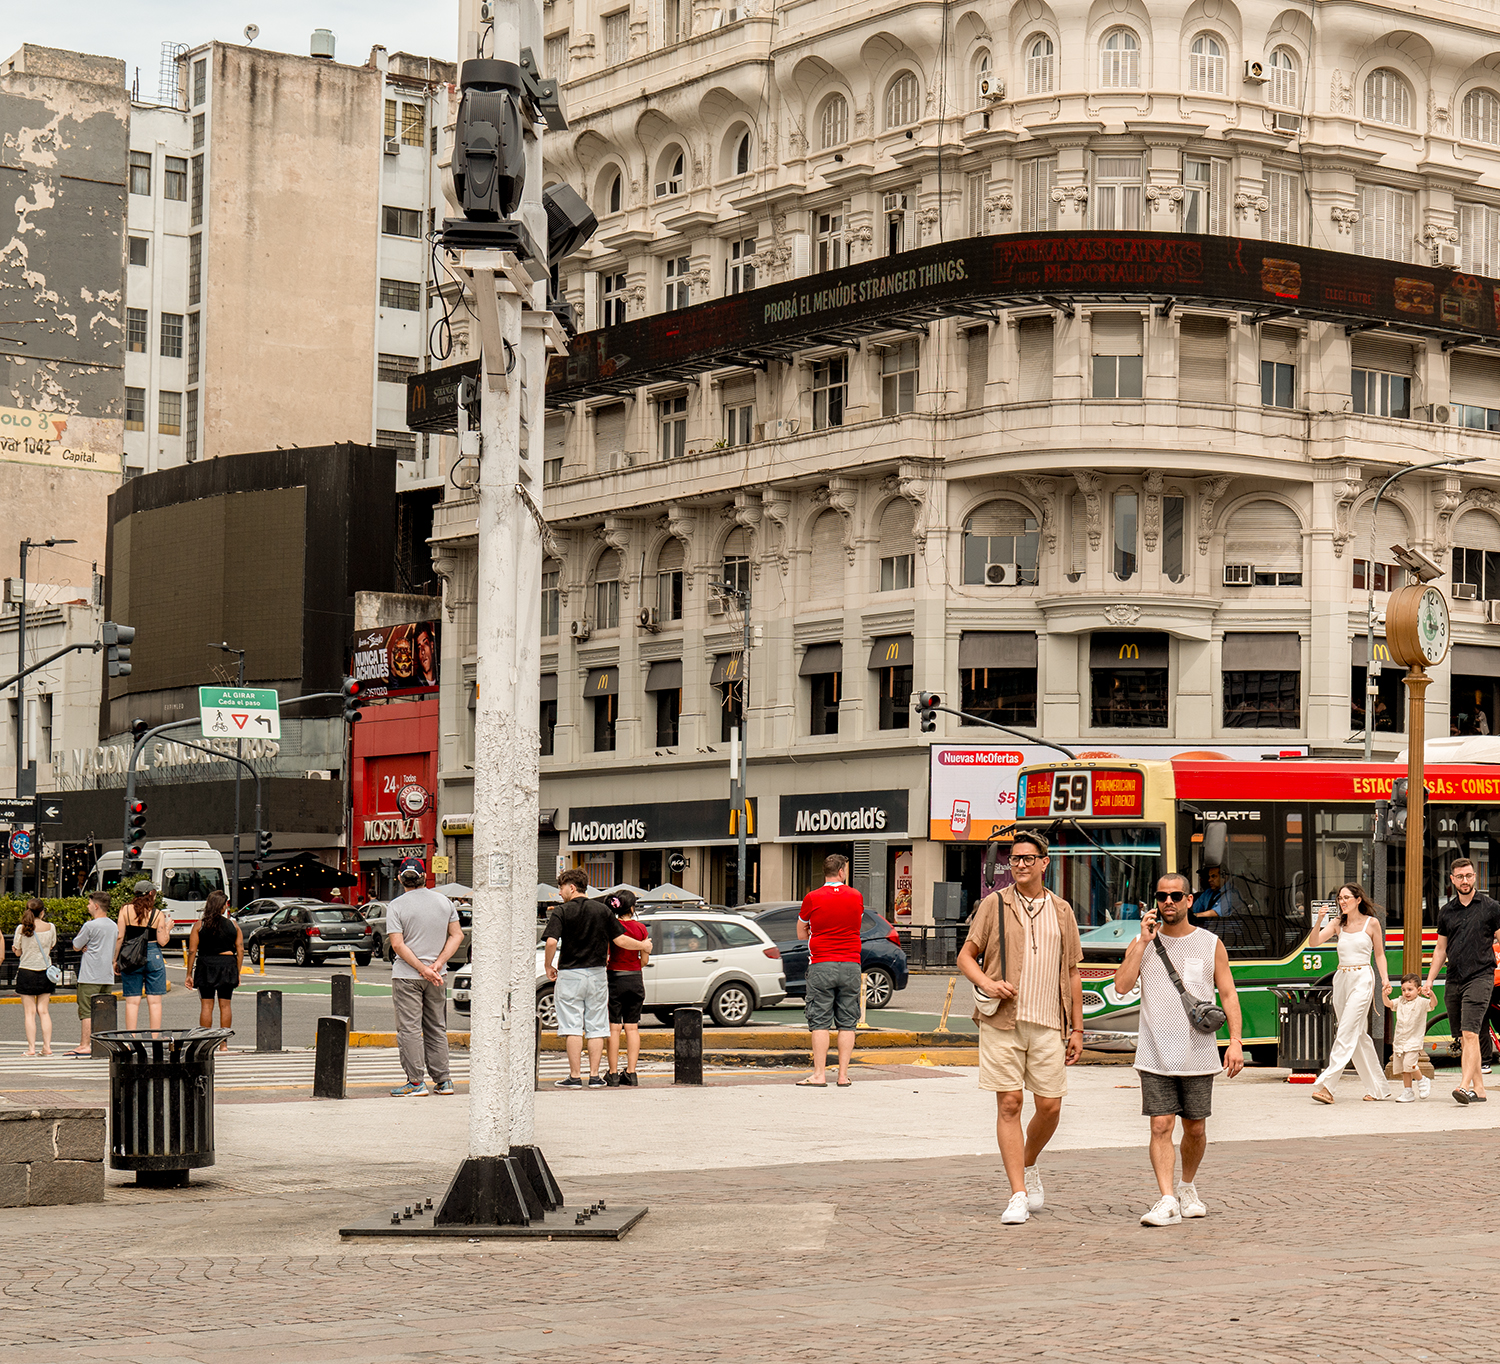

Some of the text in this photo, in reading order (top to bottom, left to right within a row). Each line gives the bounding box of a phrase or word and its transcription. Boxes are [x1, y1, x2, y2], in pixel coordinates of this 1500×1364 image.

[764, 292, 798, 324] PROBÁ
[800, 294, 812, 316] EL
[859, 269, 917, 302] STRANGER
[918, 258, 969, 288] THINGS.
[62, 449, 97, 463] Capital.
[1440, 622, 1446, 636] 3
[355, 648, 388, 667] NUNCA TE
[1426, 647, 1433, 660] 6
[356, 663, 389, 681] ACHIQUES
[222, 691, 232, 699] AL
[72, 742, 150, 777] NACIONL
[944, 752, 1019, 764] Nuevas McOfertas
[383, 775, 396, 793] 24
[403, 774, 416, 782] Todos
[1095, 779, 1136, 792] PANAMERICANA
[1353, 778, 1395, 794] ESTAC
[401, 785, 427, 800] MOSTAZA
[1053, 774, 1088, 811] 59
[1094, 794, 1135, 807] y SAN LORENZO
[795, 806, 887, 832] McDonald's
[363, 818, 423, 842] MOSTAZA
[569, 819, 646, 842] McDonald's
[1302, 954, 1322, 970] 53
